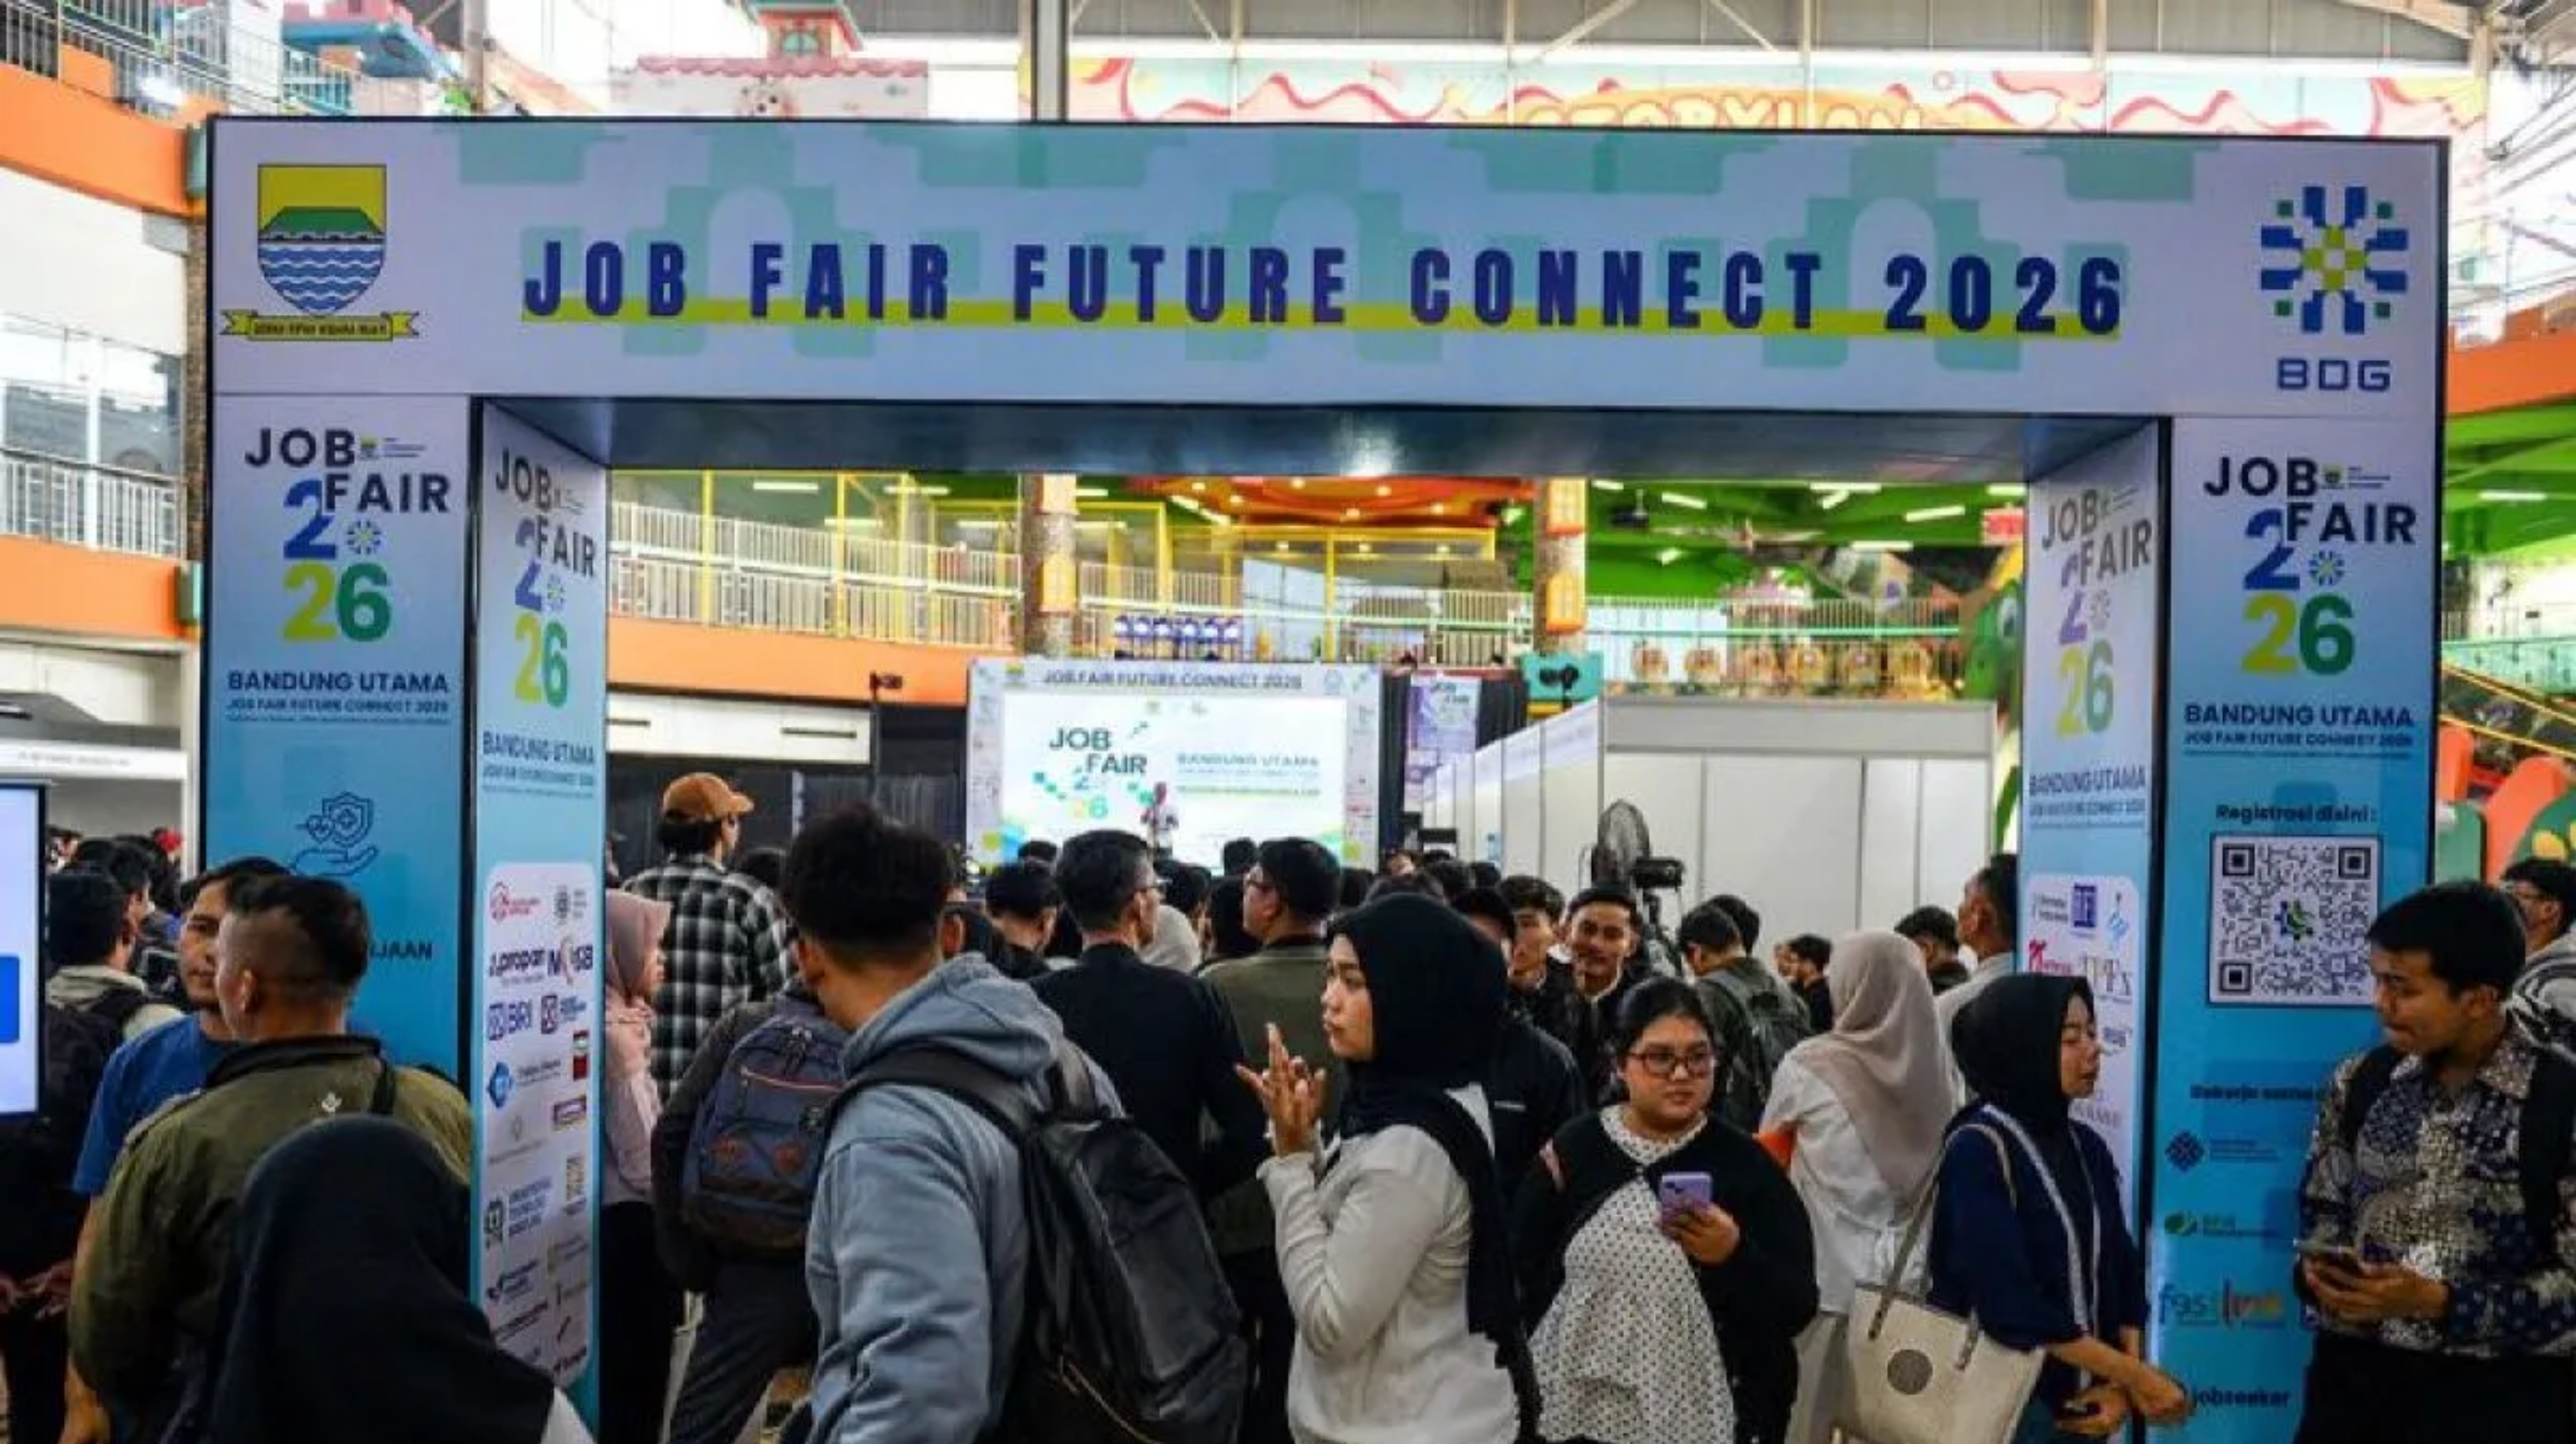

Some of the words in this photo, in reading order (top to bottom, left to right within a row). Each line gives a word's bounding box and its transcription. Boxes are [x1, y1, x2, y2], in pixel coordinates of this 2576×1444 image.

[522, 241, 687, 316] JOB
[750, 244, 949, 320] FAIR
[1013, 245, 1346, 323] FUTURE
[1410, 248, 1822, 330] CONNECT
[1884, 256, 2122, 334] 2026
[2277, 357, 2391, 391] BDG
[245, 428, 355, 467] JOB
[324, 473, 450, 513] FAIR
[496, 447, 552, 512] JOB
[2204, 457, 2318, 497] JOB
[2042, 488, 2098, 551] JOB
[2286, 502, 2416, 544] FAIR
[537, 514, 594, 577] FAIR
[2080, 518, 2153, 586] FAIR
[283, 561, 391, 643] 26
[2241, 593, 2355, 676] 26
[515, 612, 569, 708] 26
[228, 671, 354, 691] BANDUNG
[360, 672, 449, 694] UTAMA
[2057, 638, 2114, 740] 26
[2185, 705, 2314, 726] BANDUNG
[2321, 706, 2413, 728] UTAMA
[1050, 728, 1111, 750] JOB
[1086, 753, 1148, 773] FAIR
[2215, 803, 2313, 825] Registrasi
[369, 939, 433, 960] JAAN
